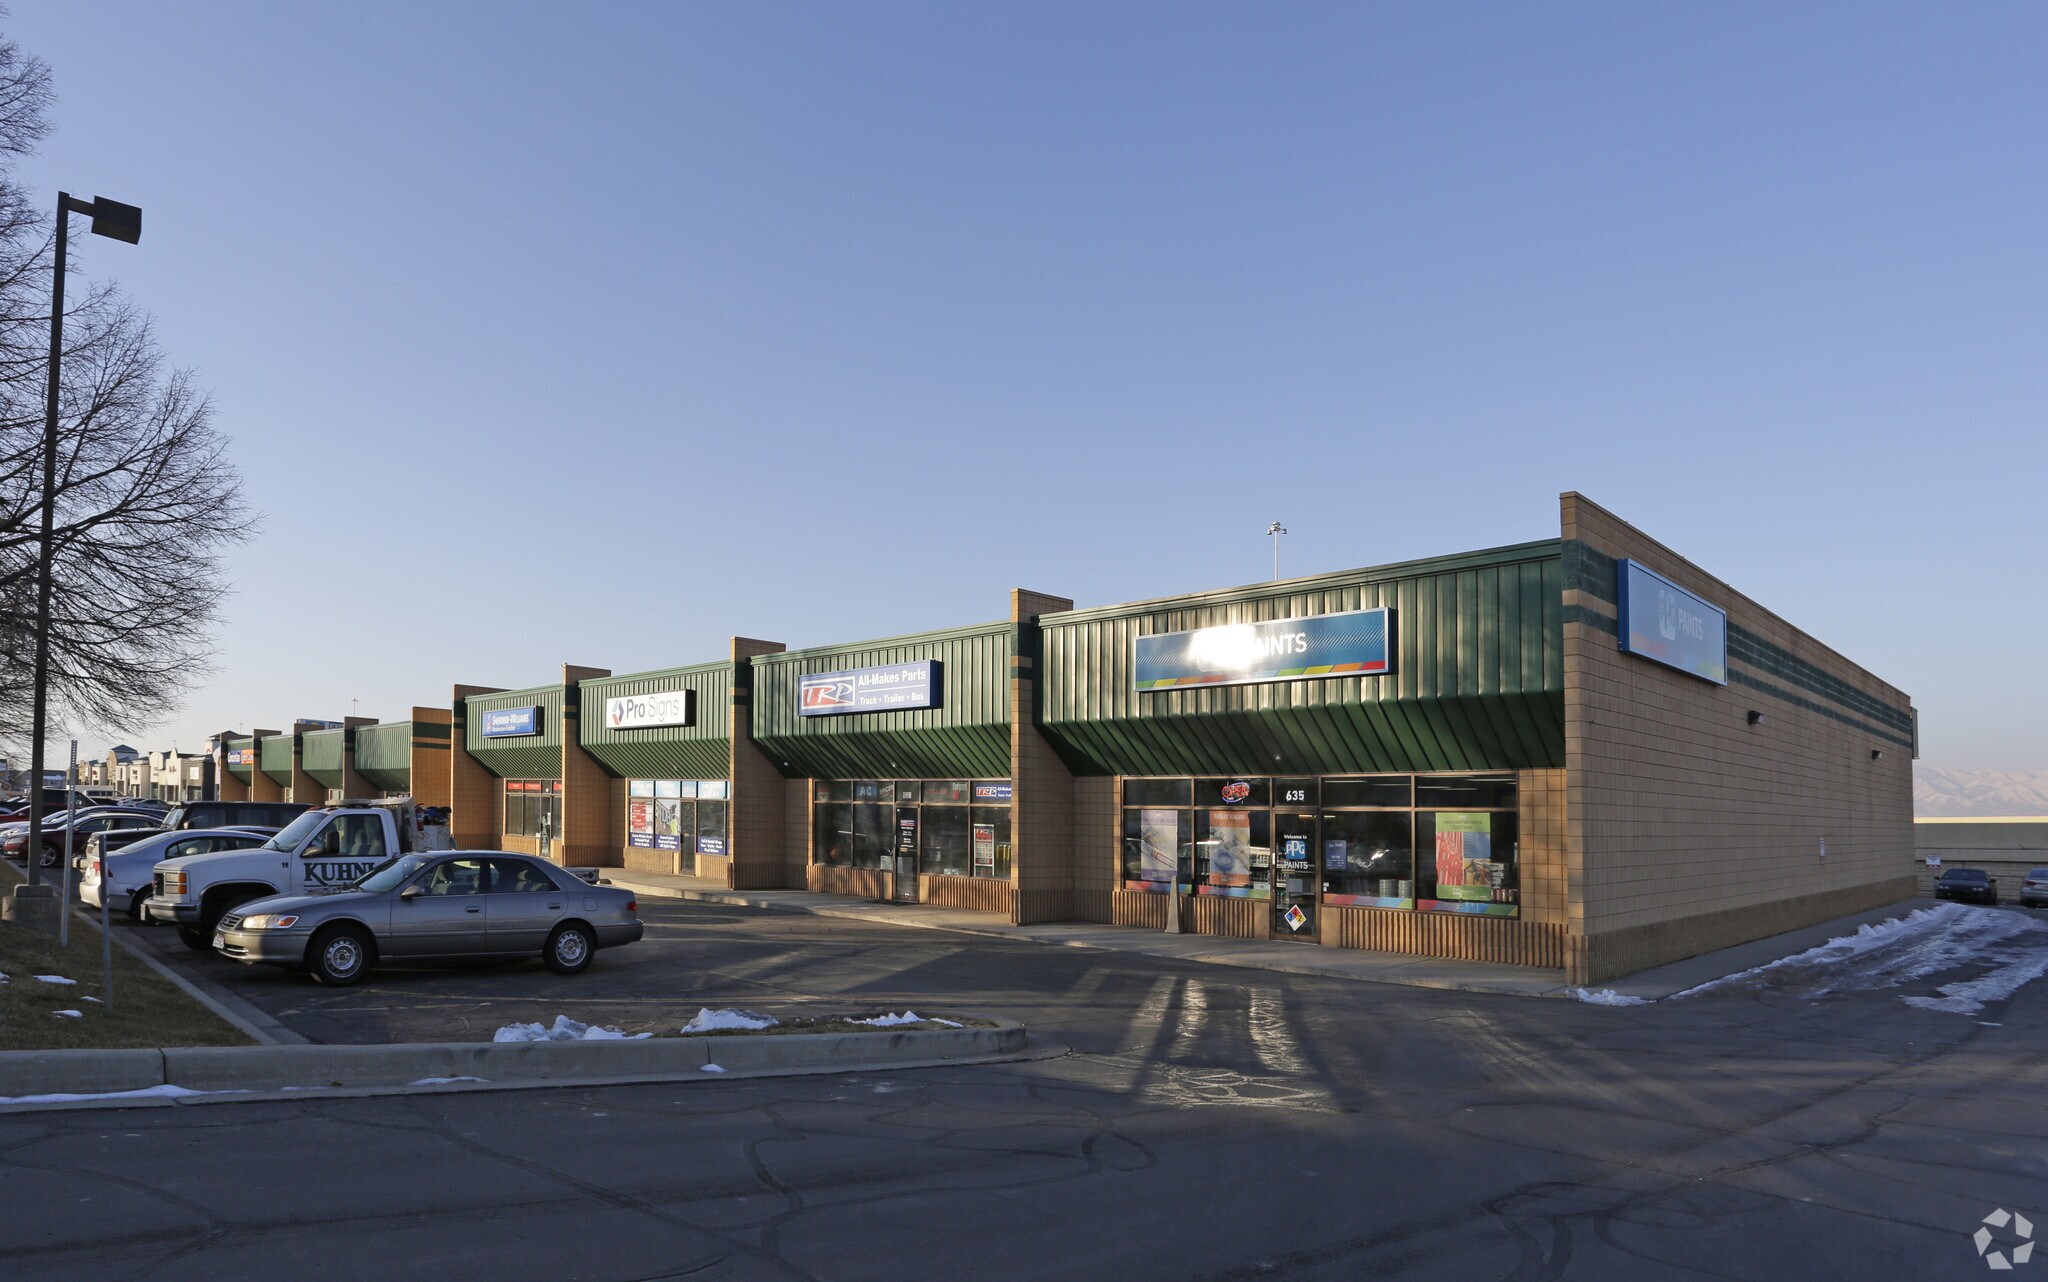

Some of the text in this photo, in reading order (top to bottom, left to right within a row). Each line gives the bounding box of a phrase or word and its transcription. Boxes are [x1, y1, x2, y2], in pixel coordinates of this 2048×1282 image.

[1678, 608, 1703, 640] PAINTS
[1251, 632, 1308, 658] AINTS
[858, 668, 927, 687] All-Makes Parts
[803, 682, 854, 704] TRP
[860, 691, 924, 706] Truck Trailer Bus
[626, 696, 680, 722] Pro Signs
[1222, 785, 1249, 798] OPEN
[1286, 790, 1305, 801] 635
[1286, 841, 1306, 857] PPG
[1284, 861, 1308, 870] PAINTS
